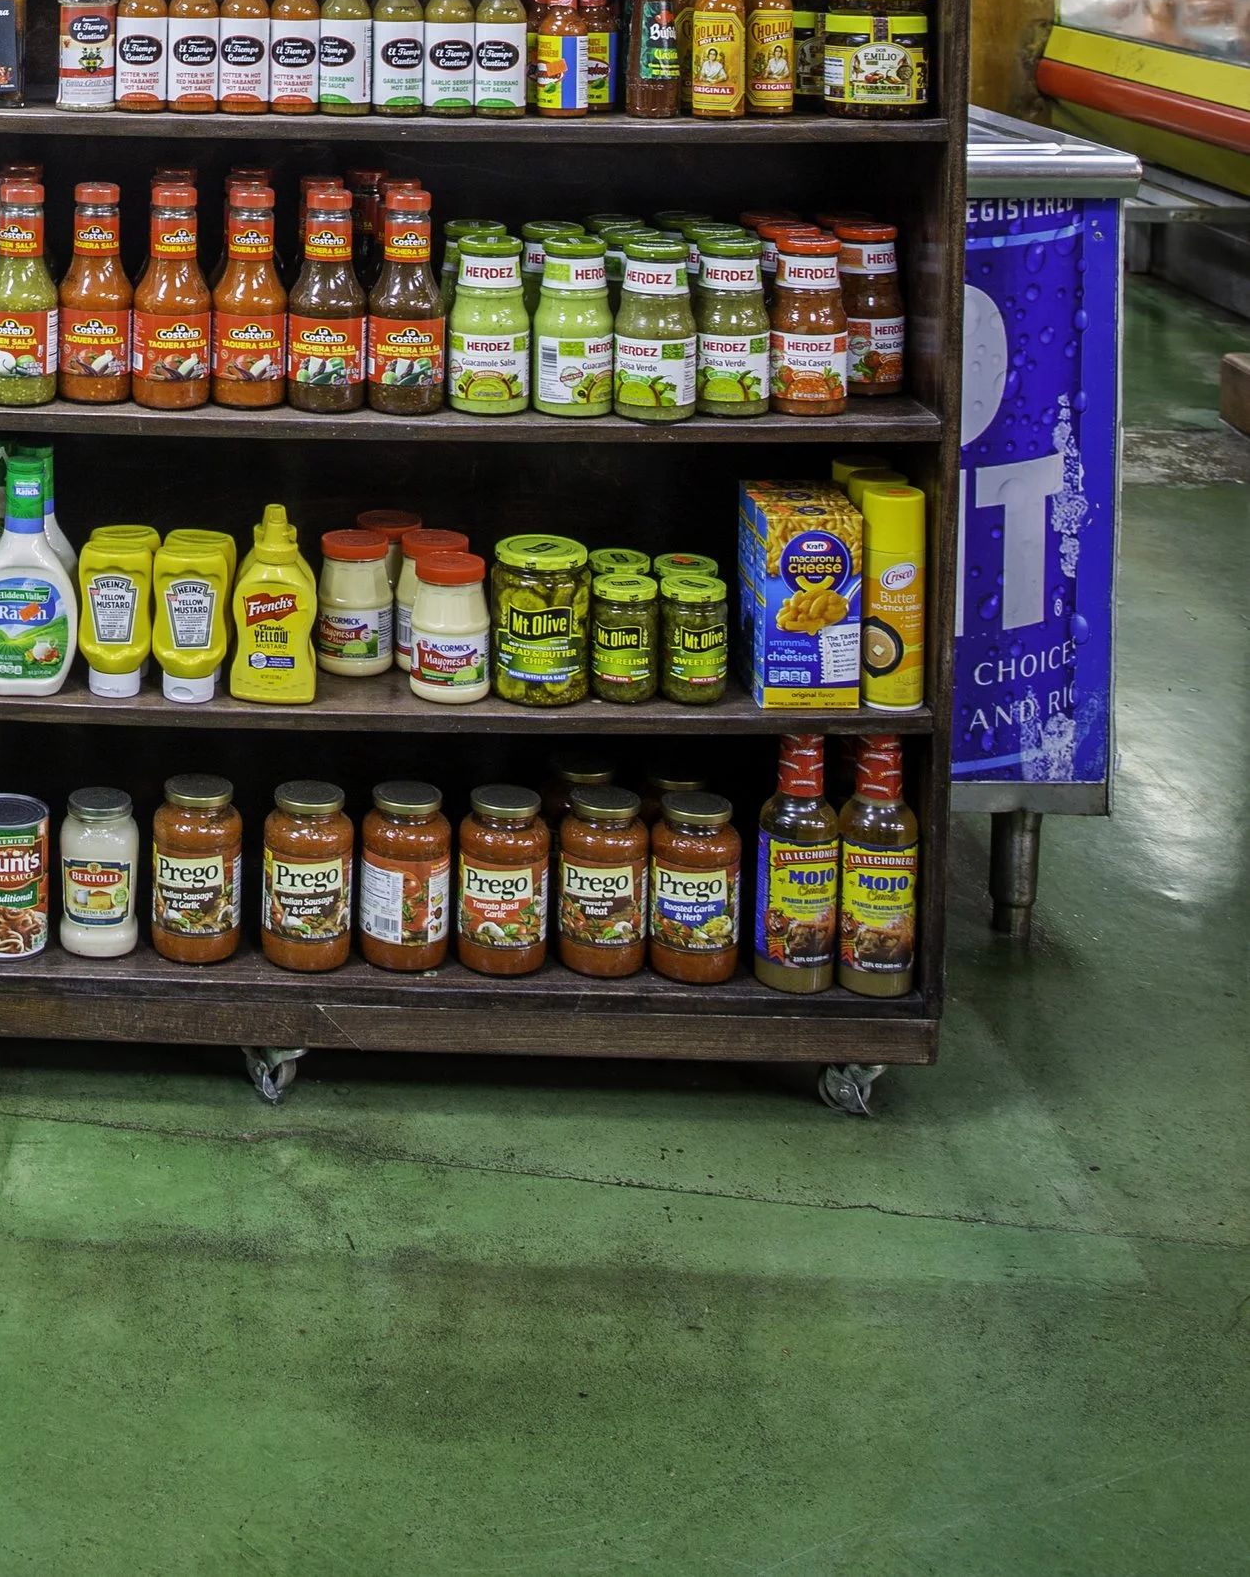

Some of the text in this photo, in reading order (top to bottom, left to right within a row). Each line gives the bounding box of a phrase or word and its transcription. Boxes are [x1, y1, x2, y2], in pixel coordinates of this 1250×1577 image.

[465, 266, 513, 279] HERDEZ
[626, 272, 672, 284] HERDEZ
[12, 337, 37, 346] SALSA
[64, 334, 99, 344] TAQUERA
[292, 342, 331, 353] RANCHERA
[467, 341, 510, 353] HERDEZ
[462, 358, 498, 367] Guacamole
[705, 358, 746, 367] Salsa Verde
[788, 357, 831, 367] Salsa Casera
[636, 363, 657, 372] Verde
[806, 542, 824, 550] Kraft
[885, 570, 913, 585] Crisco
[100, 581, 125, 589] HEINZ
[177, 586, 204, 594] HEINZ
[24, 591, 46, 601] Valley
[880, 591, 917, 604] Butter
[174, 606, 208, 614] MUSTARD
[248, 598, 293, 615] French's
[512, 612, 567, 635] Mt. Olive
[611, 632, 637, 646] Olive
[432, 643, 471, 652] McCORMICK
[502, 643, 577, 658] BREAD BUTTER
[424, 652, 466, 667] Mayonesa
[523, 657, 553, 665] CHIPS
[673, 657, 701, 665] SWEET
[768, 652, 818, 662] cheesiest
[969, 696, 1037, 732] AND
[780, 852, 793, 861] LA
[851, 855, 914, 865] LA LECHONERA
[10, 873, 34, 881] SAUCE
[71, 872, 119, 883] BERTOLLI
[158, 858, 218, 888] Prego
[789, 868, 835, 884] MOJO
[276, 864, 338, 893] Prego
[858, 874, 909, 890] MOJO
[466, 868, 528, 900] Prego
[183, 891, 213, 902] Sausage
[280, 896, 301, 905] Italian
[179, 899, 200, 909] Garlic
[472, 899, 519, 910] Tomato Basil
[664, 902, 690, 913] Roasted
[299, 905, 322, 915] Garlic
[585, 906, 608, 915] Meat
[683, 912, 702, 921] Herb
